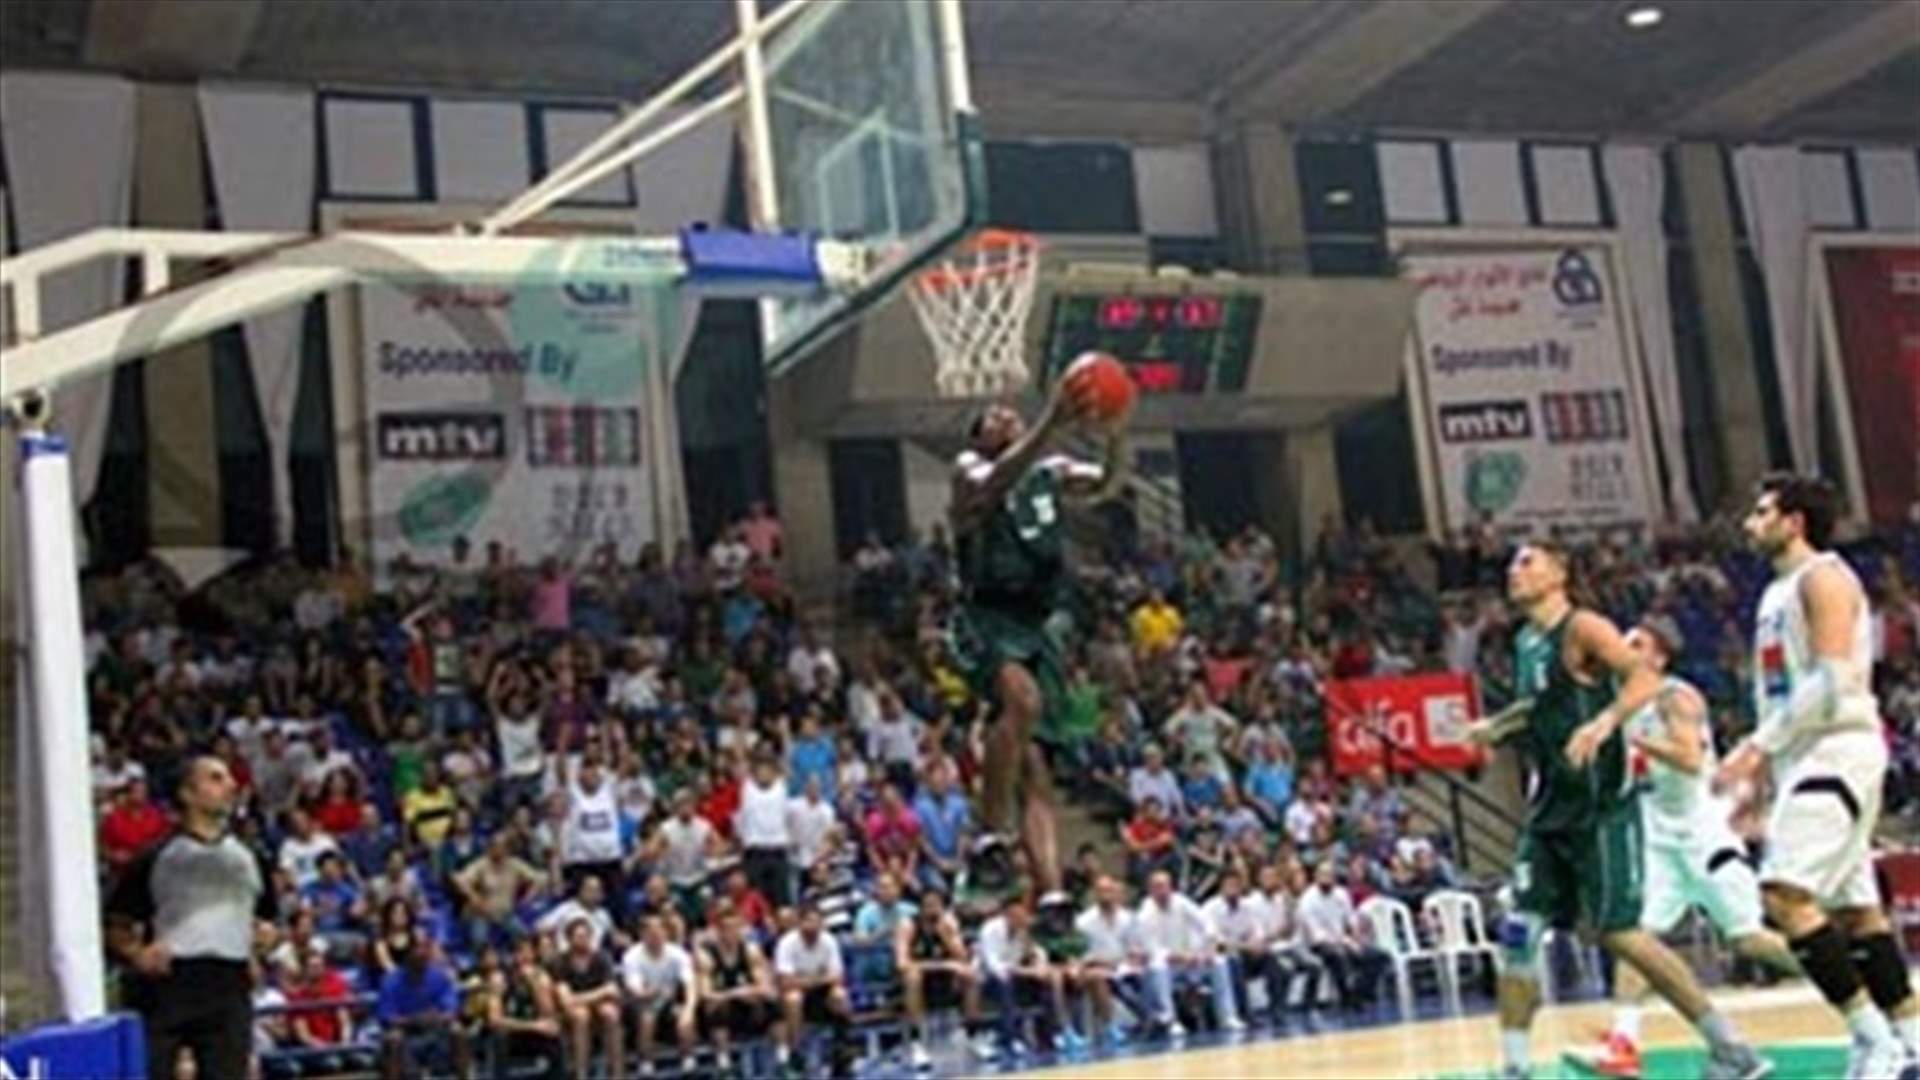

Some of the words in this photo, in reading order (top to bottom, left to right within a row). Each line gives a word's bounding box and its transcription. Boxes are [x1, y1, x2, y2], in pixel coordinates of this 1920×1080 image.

[379, 341, 530, 379] Sponsored
[539, 341, 577, 382] By
[1431, 339, 1540, 376] Sponsored
[1546, 339, 1574, 373] By
[385, 420, 499, 452] mtv
[1444, 407, 1527, 437] mtv
